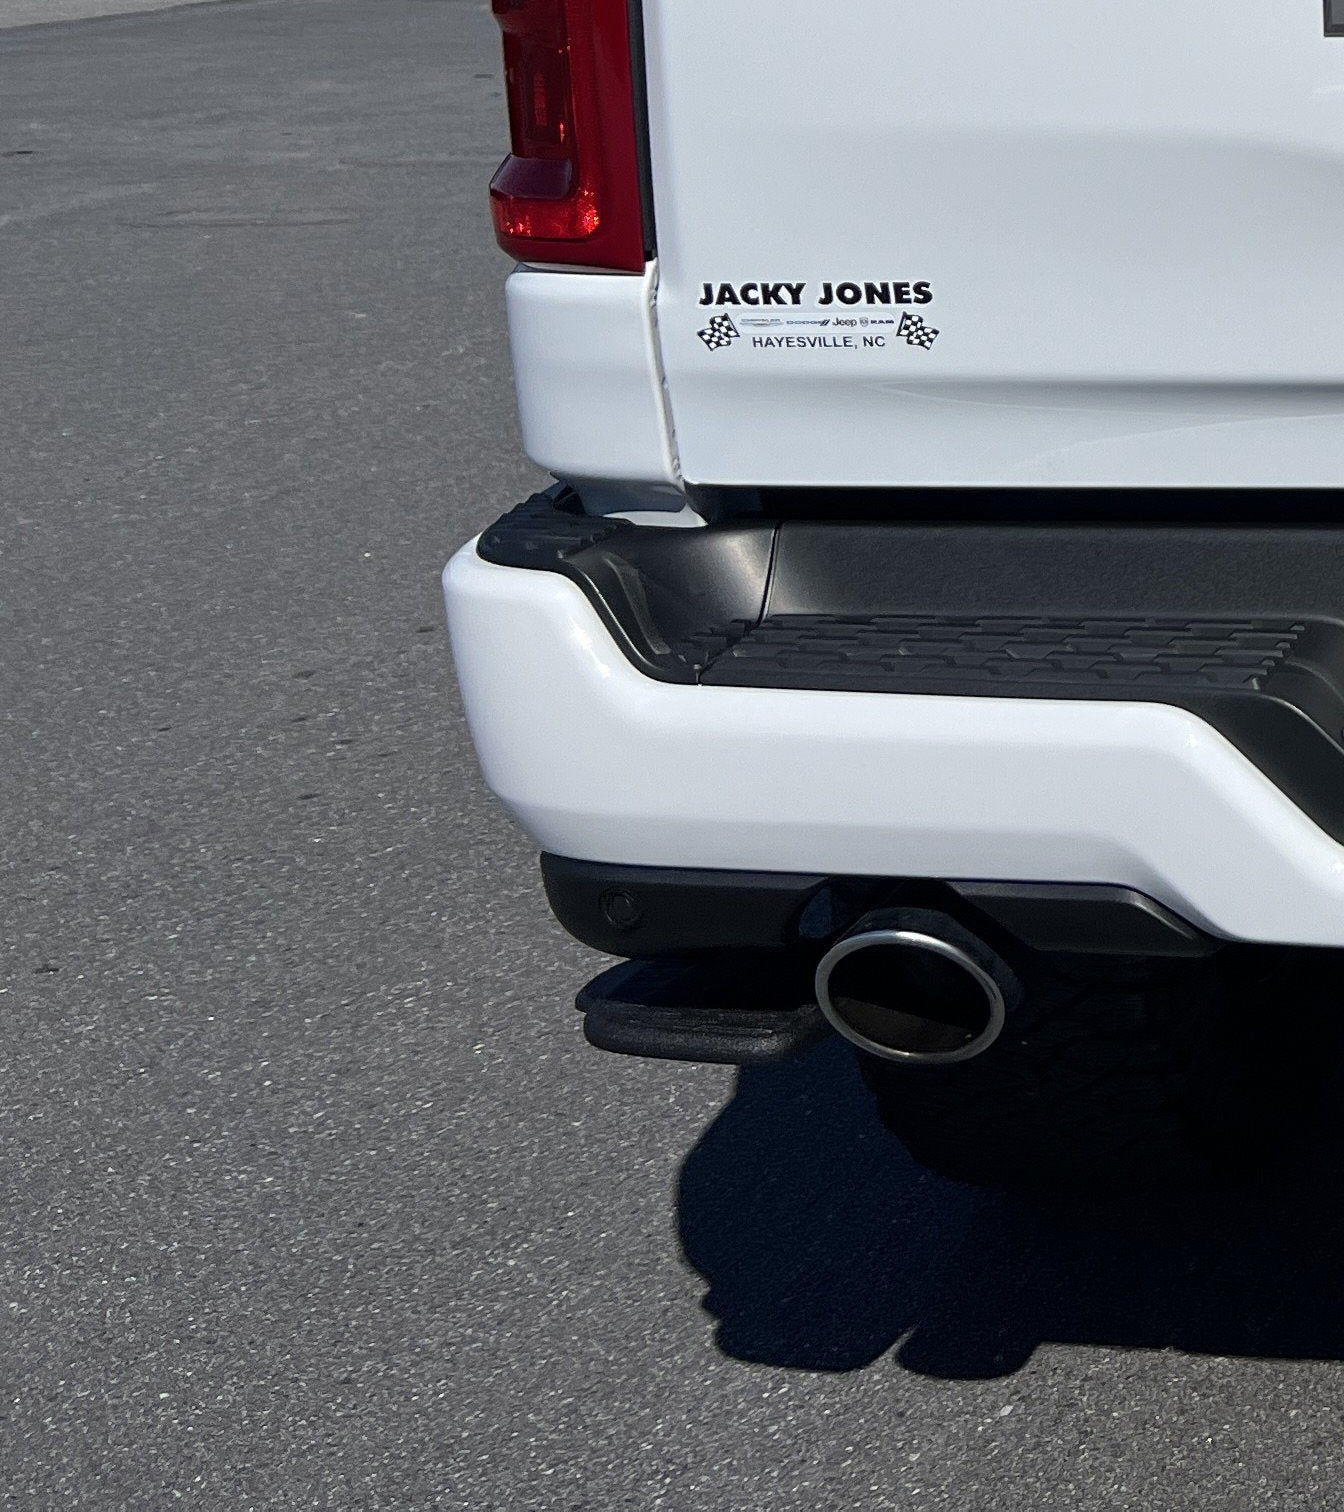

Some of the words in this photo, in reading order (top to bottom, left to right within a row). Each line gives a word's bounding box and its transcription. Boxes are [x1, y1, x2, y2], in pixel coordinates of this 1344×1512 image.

[699, 282, 807, 306] JACKY
[817, 281, 934, 305] JONES
[832, 317, 858, 327] Jeep
[752, 336, 858, 350] HAYESVILLE,
[863, 336, 886, 348] NC
